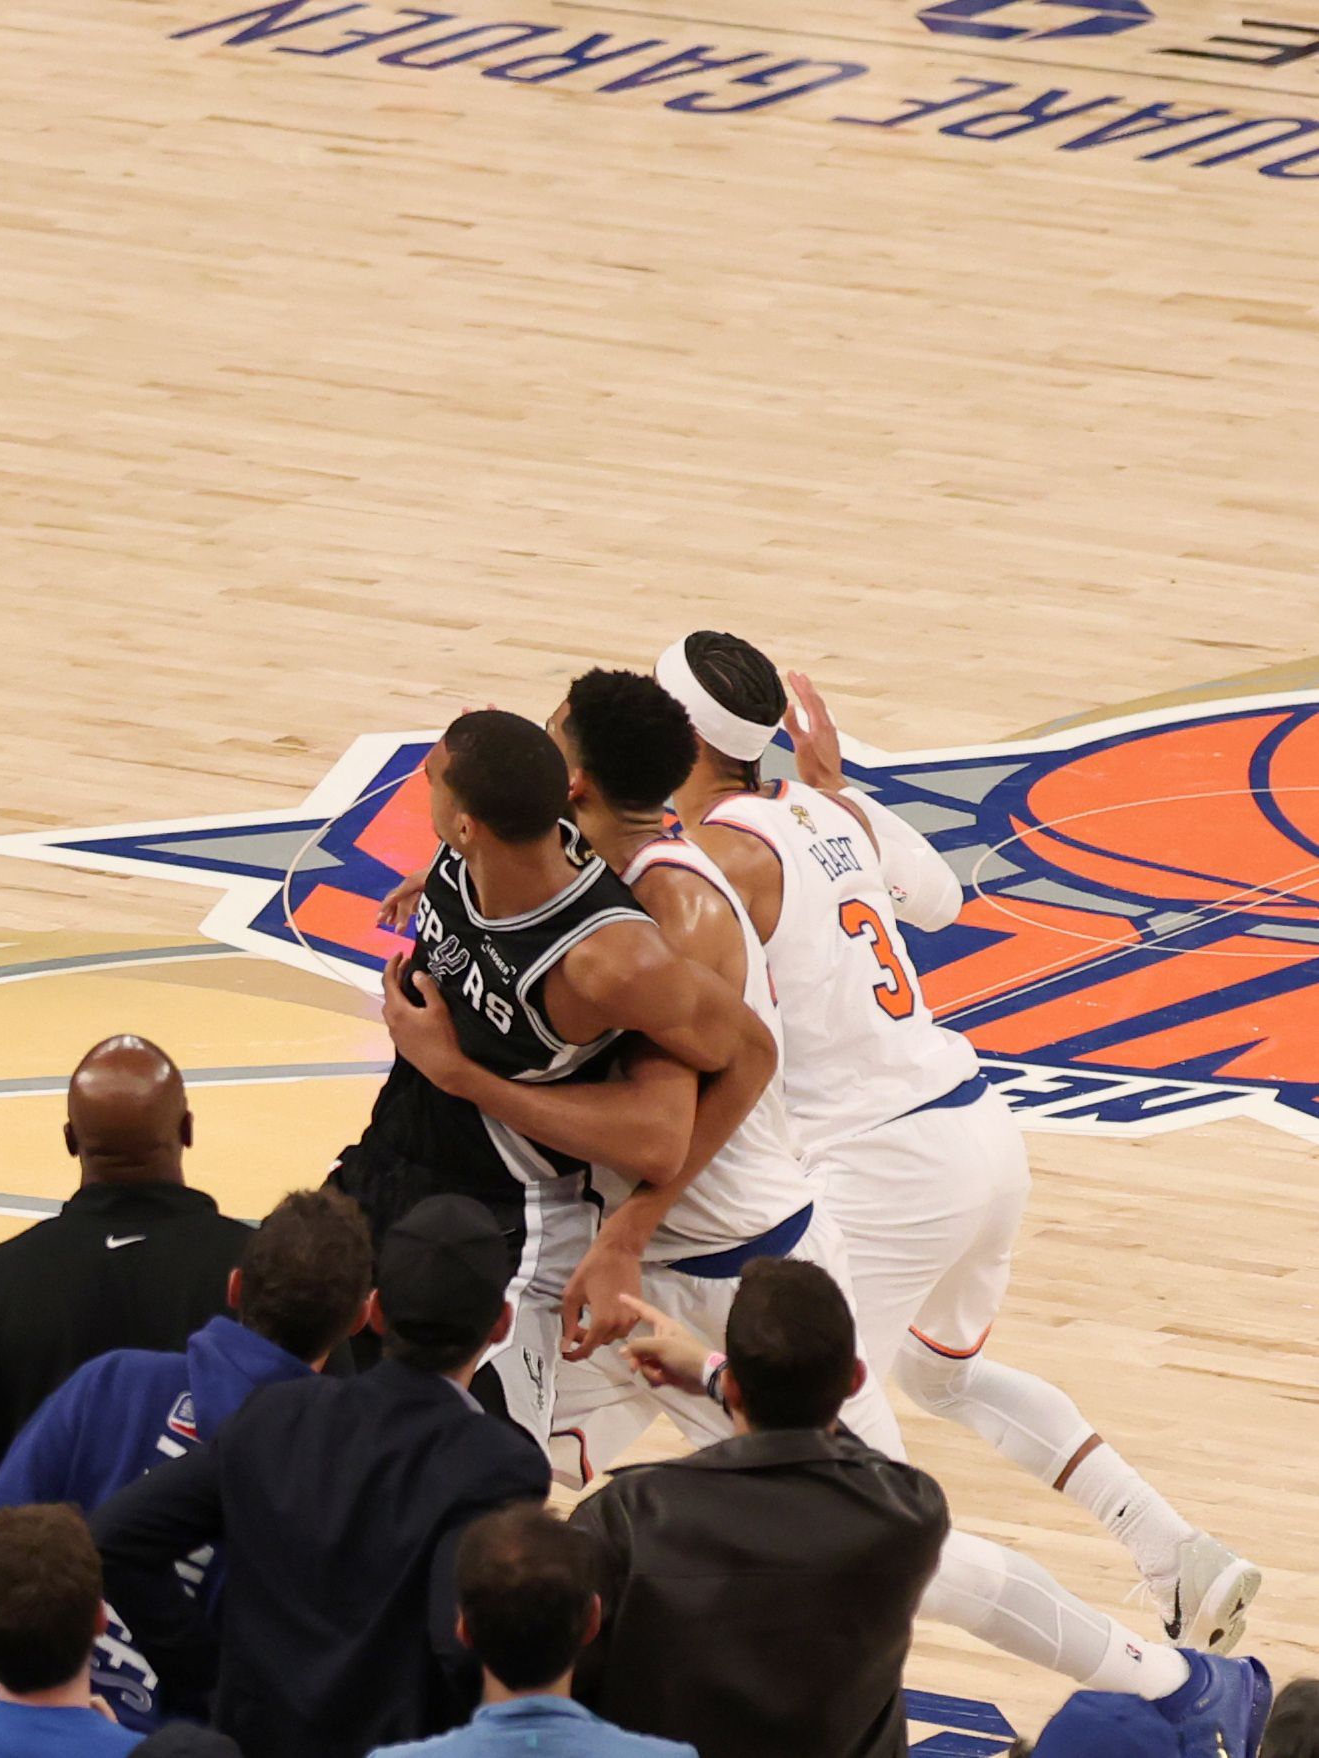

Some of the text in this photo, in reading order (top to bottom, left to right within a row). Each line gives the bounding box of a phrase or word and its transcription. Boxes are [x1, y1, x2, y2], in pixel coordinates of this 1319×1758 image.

[169, 0, 869, 113] GARDEN
[808, 836, 863, 882] HART
[839, 898, 915, 1021] 3
